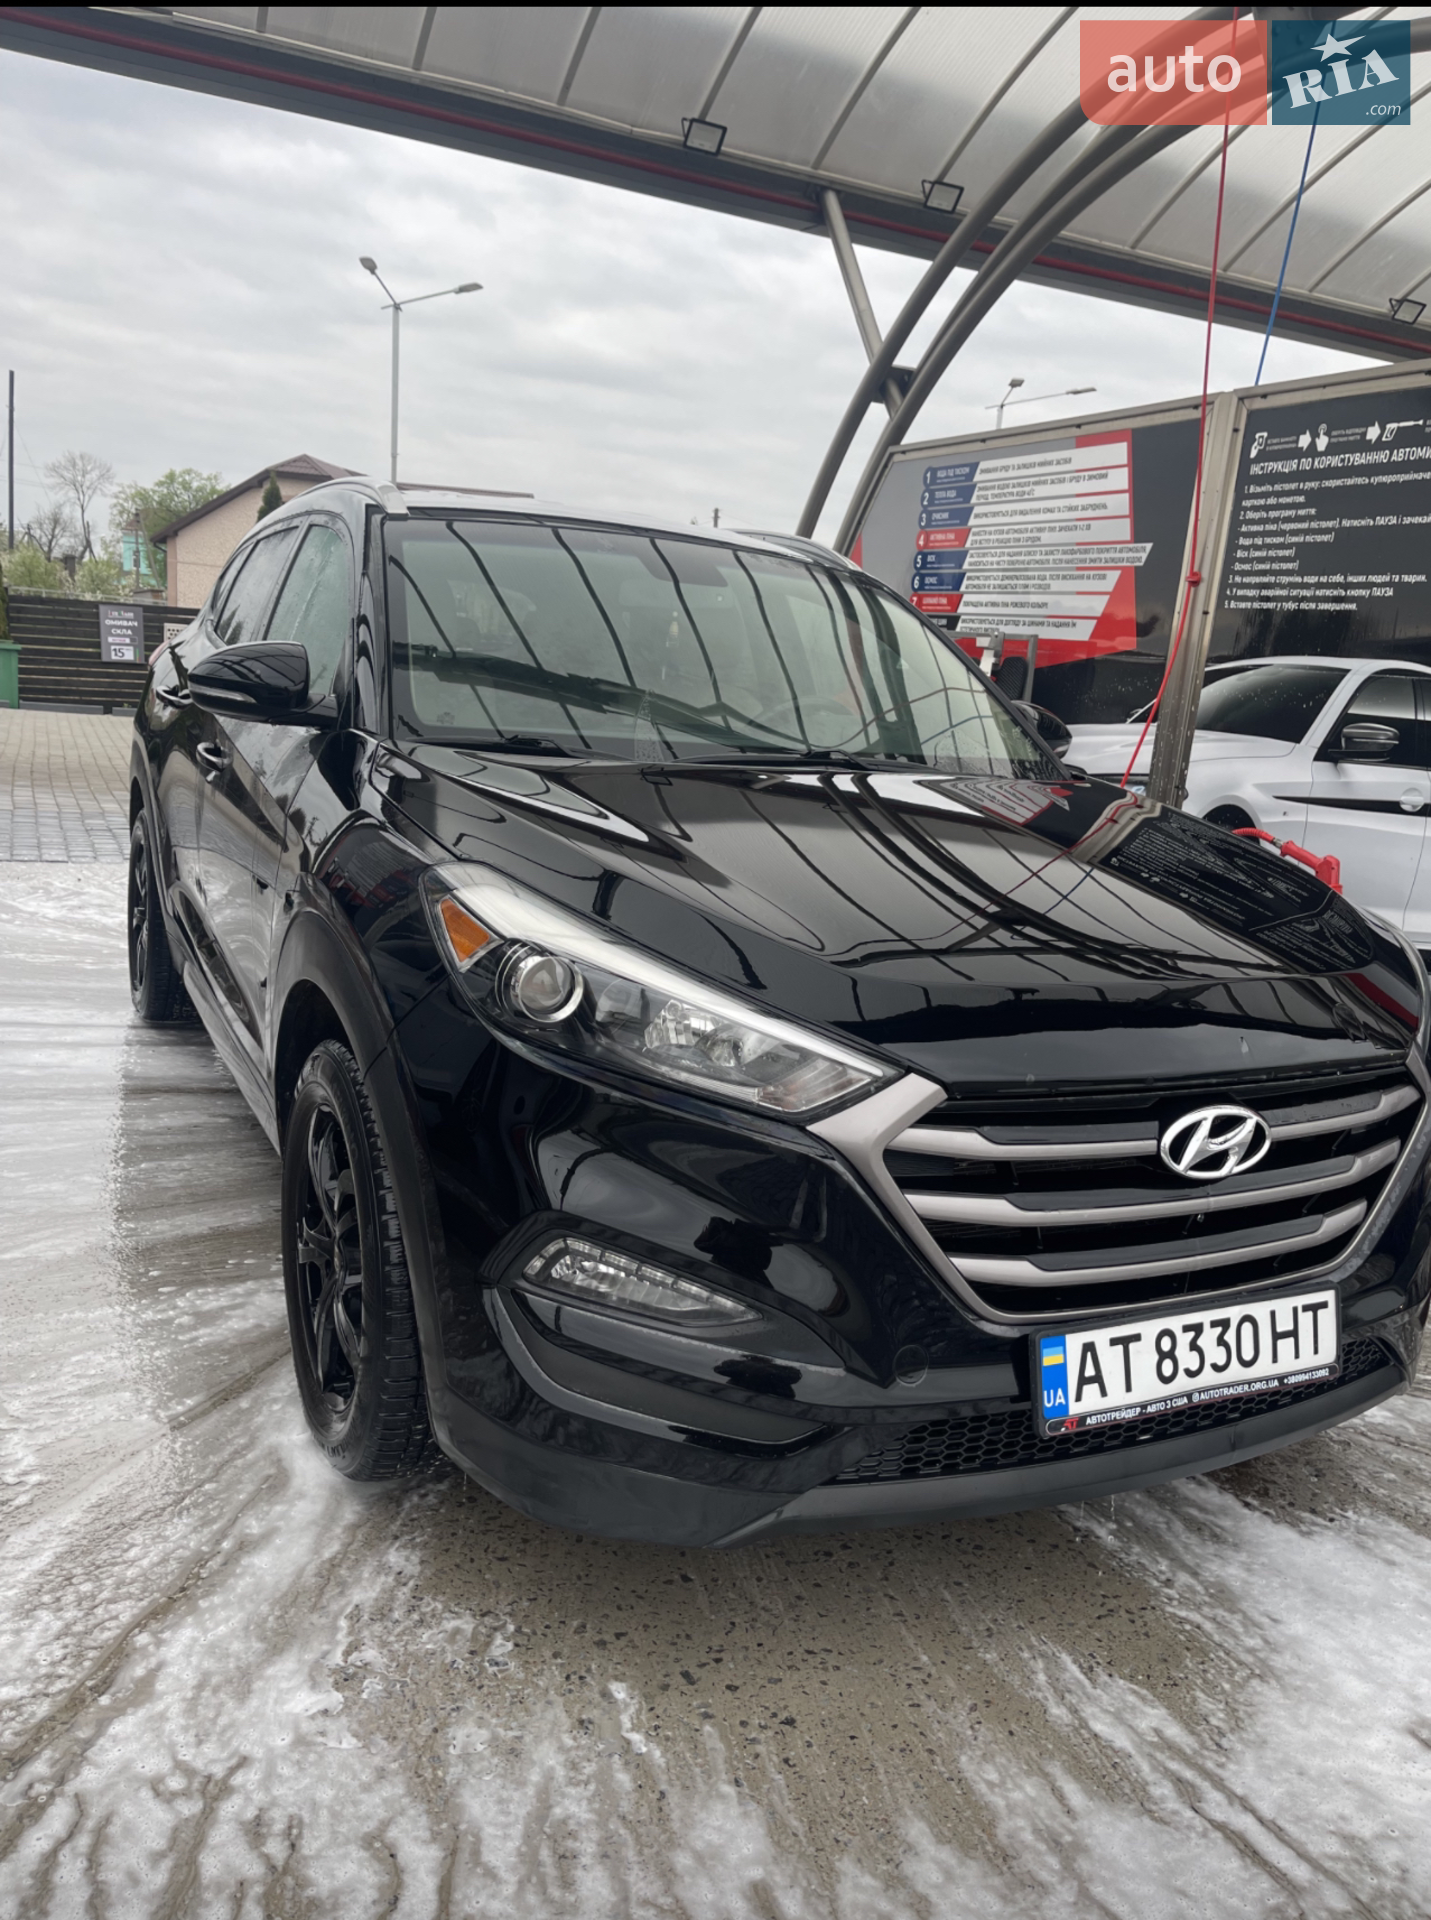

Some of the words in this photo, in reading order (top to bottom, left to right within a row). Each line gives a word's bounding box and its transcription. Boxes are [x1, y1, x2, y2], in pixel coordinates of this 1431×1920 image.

[1250, 458, 1298, 476] ІНСТРУКЦІЯ
[1299, 457, 1312, 471] ПО
[1313, 450, 1390, 469] КОРИСТУВАННЮ
[926, 470, 931, 484] 1
[923, 492, 929, 505] 2
[921, 513, 926, 526] 3
[1375, 516, 1397, 526] ПАУЗА
[918, 534, 924, 547] 4
[916, 555, 922, 567] 5
[914, 576, 919, 589] 6
[1371, 587, 1394, 596] ПАУЗА
[112, 648, 125, 658] 15
[1074, 1333, 1142, 1403] AT
[1155, 1314, 1260, 1385] 8330
[1270, 1300, 1329, 1364] HT
[1044, 1388, 1066, 1408] UA
[1086, 1407, 1141, 1426] АВТОТРЕЙДЕР
[1146, 1402, 1165, 1413] АВТО
[1172, 1396, 1189, 1408] США
